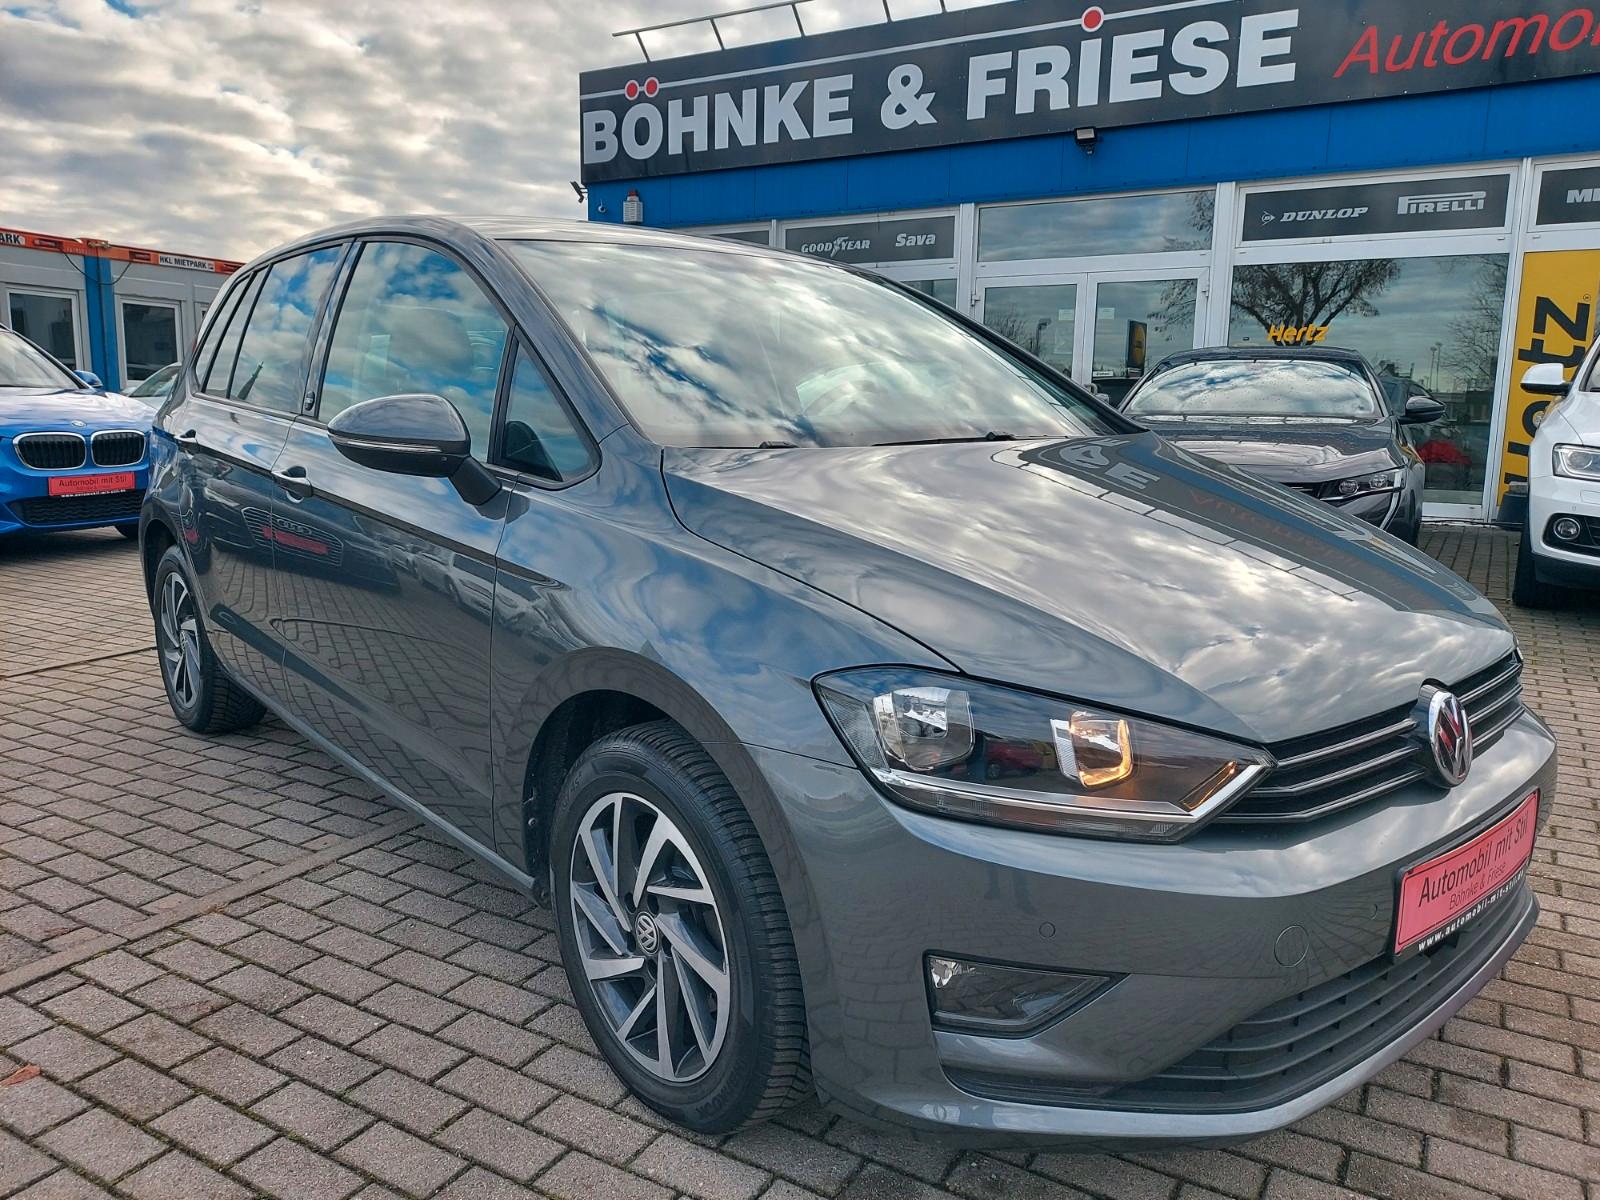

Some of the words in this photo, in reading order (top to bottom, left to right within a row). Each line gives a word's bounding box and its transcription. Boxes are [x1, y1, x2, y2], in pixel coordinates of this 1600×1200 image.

[582, 74, 853, 164] BÖHNKE
[880, 63, 937, 130] &
[966, 7, 1299, 120] FRIESE
[1332, 8, 1600, 78] Automo
[1280, 207, 1369, 222] DUNLOP
[1397, 191, 1486, 214] PIRELLI
[801, 237, 870, 257] GOODYEAR
[895, 233, 936, 247] Sava
[174, 257, 207, 269] MIETPARK
[1266, 323, 1329, 342] Hertz
[59, 478, 99, 487] Automobil
[101, 476, 113, 484] mit
[116, 475, 127, 483] Stil
[1418, 840, 1492, 908] Automobil
[1494, 827, 1513, 861] mit
[1514, 810, 1529, 844] Stil
